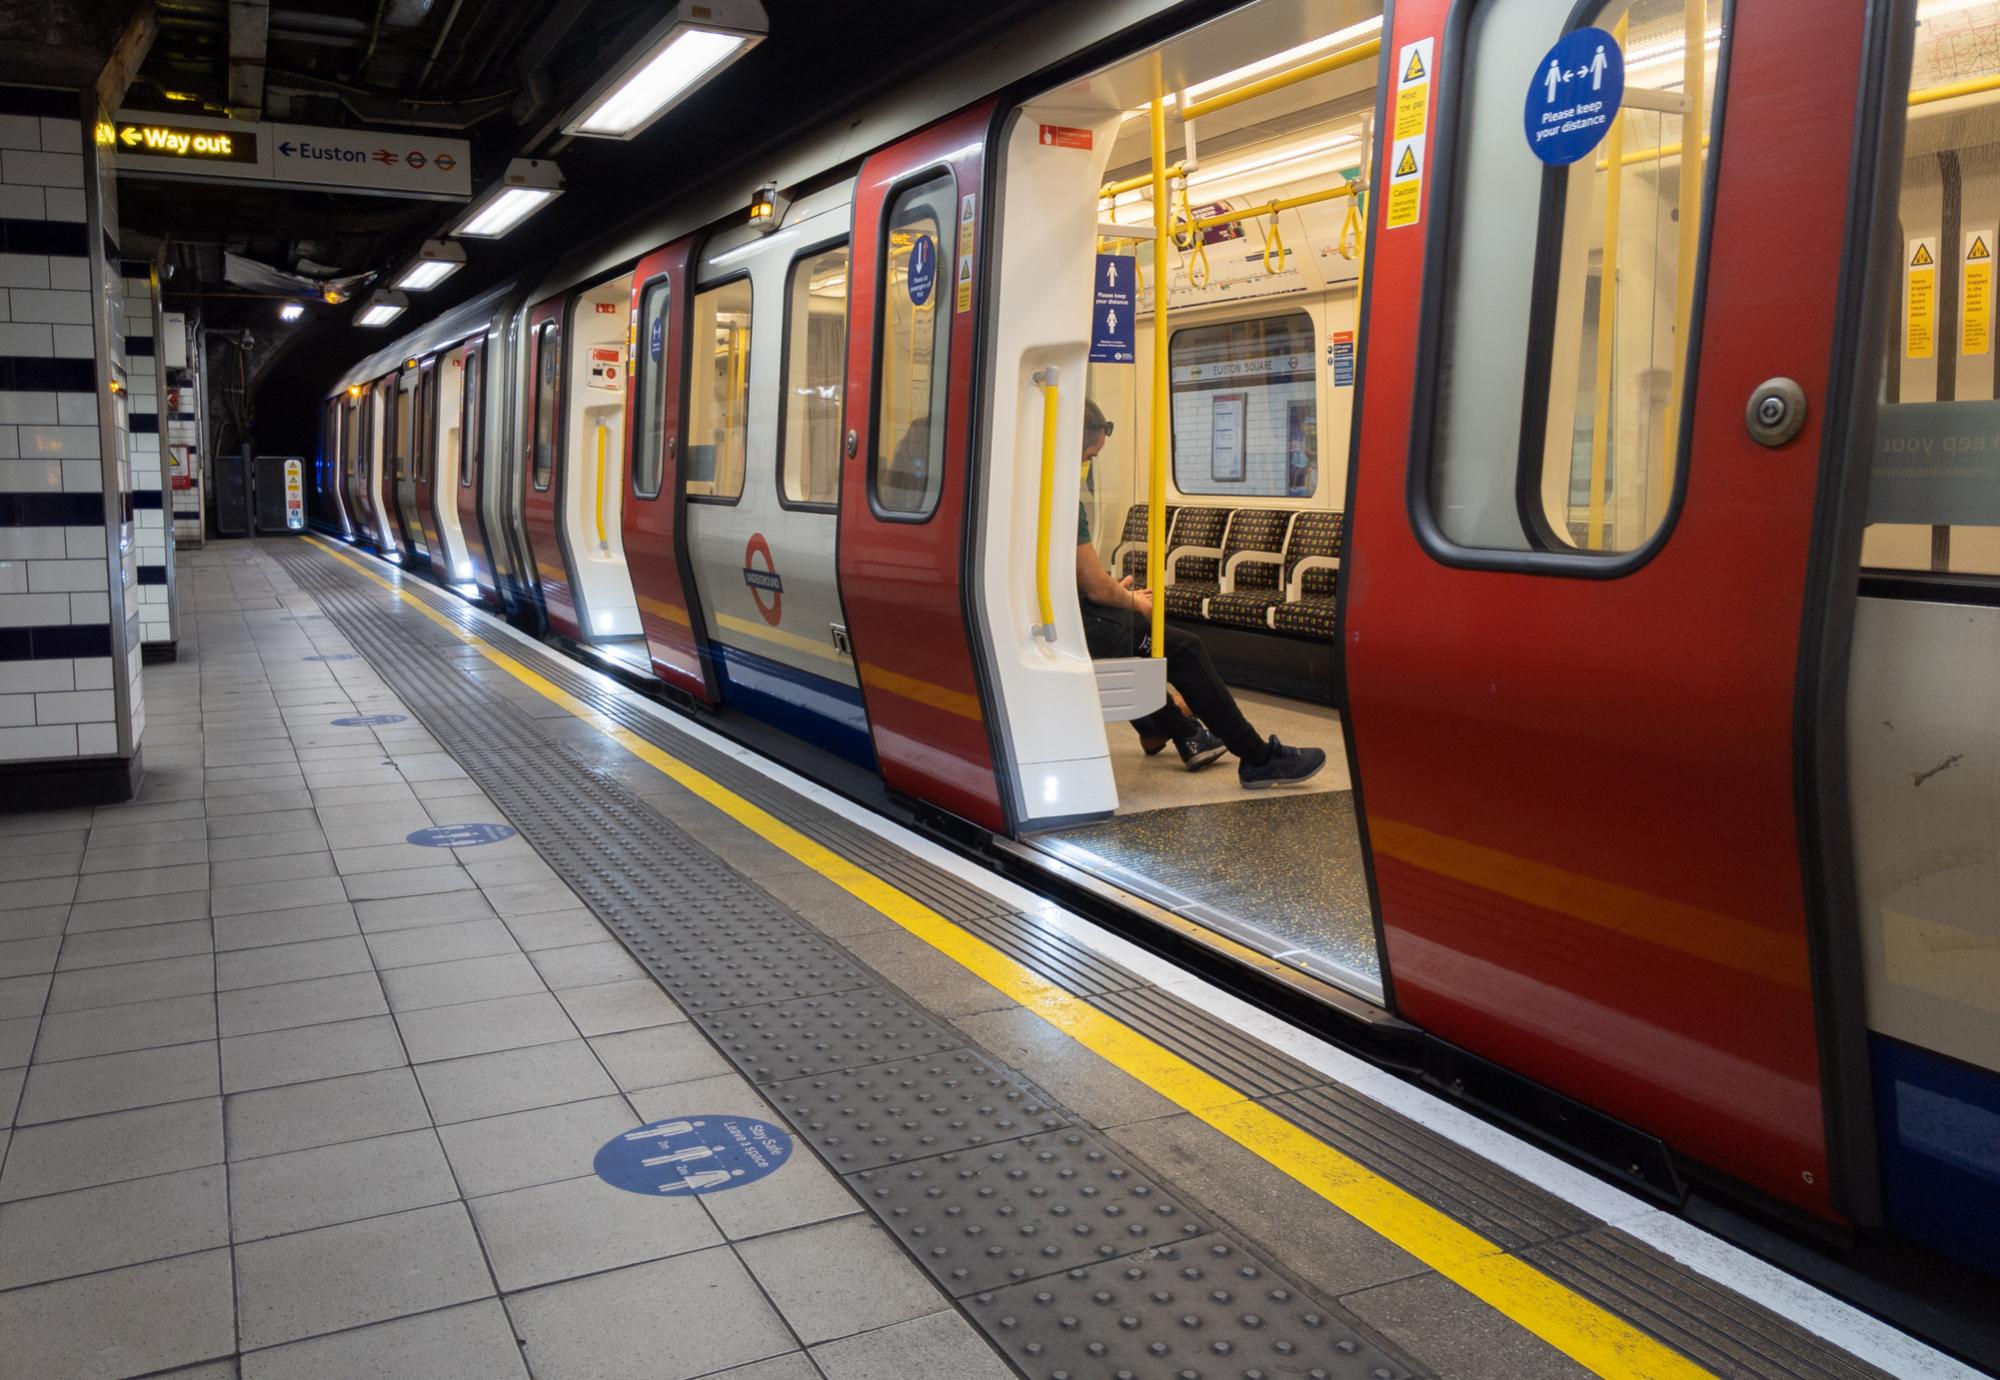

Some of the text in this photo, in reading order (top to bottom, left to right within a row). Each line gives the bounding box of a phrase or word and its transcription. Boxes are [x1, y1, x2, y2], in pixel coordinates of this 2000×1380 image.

[1541, 101, 1603, 124] Please keep
[1535, 114, 1606, 142] your distance
[144, 128, 232, 154] Way out
[300, 143, 366, 163] Euston
[1213, 360, 1273, 376] EUSTON SQUARE
[745, 572, 780, 589] UNDERGROUND
[723, 1121, 747, 1142] Leave
[744, 1146, 769, 1169] space
[749, 1124, 784, 1156] Stay Safe
